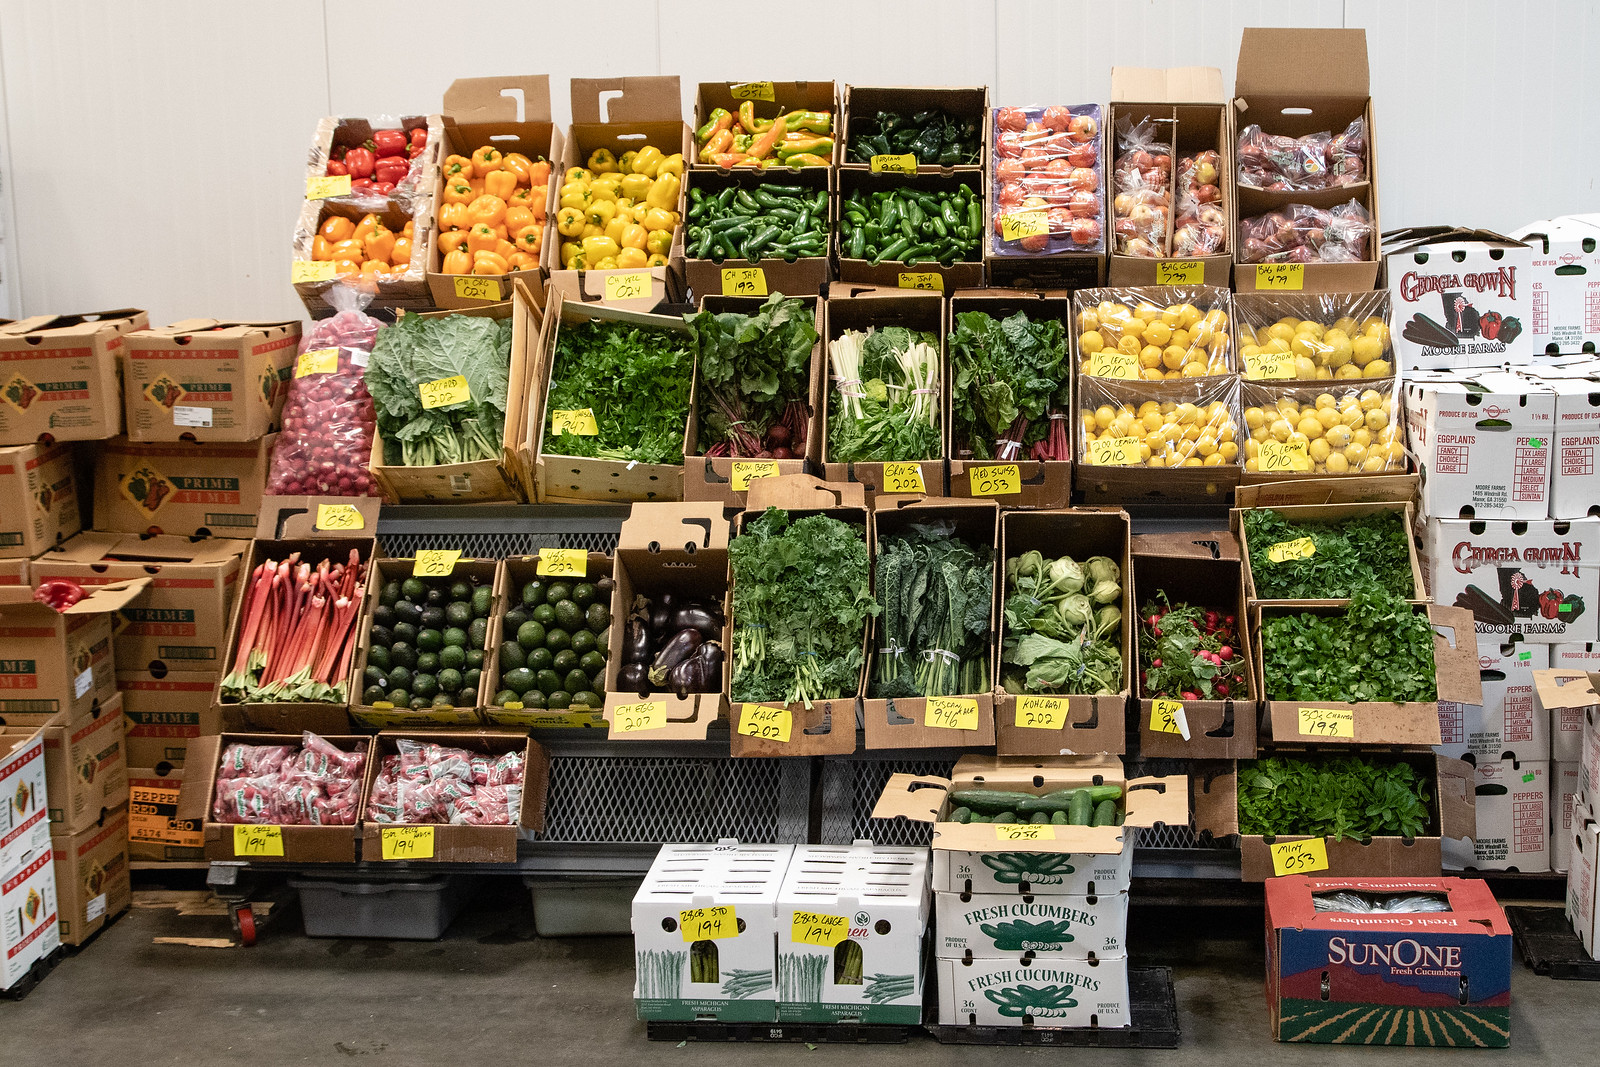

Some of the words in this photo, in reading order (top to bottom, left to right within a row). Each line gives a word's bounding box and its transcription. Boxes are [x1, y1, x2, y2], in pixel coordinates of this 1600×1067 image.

[734, 282, 754, 293] 193
[1400, 269, 1462, 302] GEORGIA
[1464, 266, 1517, 300] GROWN
[1421, 345, 1466, 356] MOORE
[1468, 342, 1506, 355] FARMS
[1098, 365, 1126, 378] 010
[1437, 434, 1476, 444] EGGPLANTS
[1562, 436, 1600, 446] EGGPLANTS
[1100, 450, 1126, 464] 010
[1266, 454, 1292, 469] 010
[183, 478, 232, 490] PRIME
[892, 479, 919, 490] 202
[980, 479, 1008, 492] 053
[1452, 542, 1520, 574] GEORGIA
[1523, 542, 1582, 578] GROWN
[136, 610, 188, 622] PRIME
[1474, 623, 1521, 634] MOORE
[1524, 623, 1566, 634] FARMS
[141, 713, 192, 724] PRIME
[625, 716, 651, 730] 207
[934, 708, 958, 728] 946
[1026, 712, 1054, 725] 202
[748, 723, 780, 738] 202
[1310, 720, 1338, 736] 198
[1513, 792, 1544, 800] PEPPERS
[132, 804, 158, 814] RED
[168, 820, 194, 831] CHO
[244, 837, 266, 852] 194
[393, 840, 414, 856] 194
[1278, 844, 1302, 854] MINT
[1284, 852, 1315, 868] 053
[958, 865, 971, 873] 36
[964, 904, 1008, 926] FRESH
[1011, 904, 1098, 927] CUCUMBERS
[1329, 916, 1414, 926] Cucumbers
[1417, 916, 1458, 926] Fresh
[697, 920, 722, 938] 194
[804, 926, 832, 942] 194
[1104, 937, 1117, 945] 36
[1390, 966, 1414, 976] Fresh
[1414, 968, 1461, 978] Cucumbers
[968, 970, 1012, 992] FRESH
[1014, 970, 1102, 992] CUCUMBERS
[962, 1000, 975, 1008] 36
